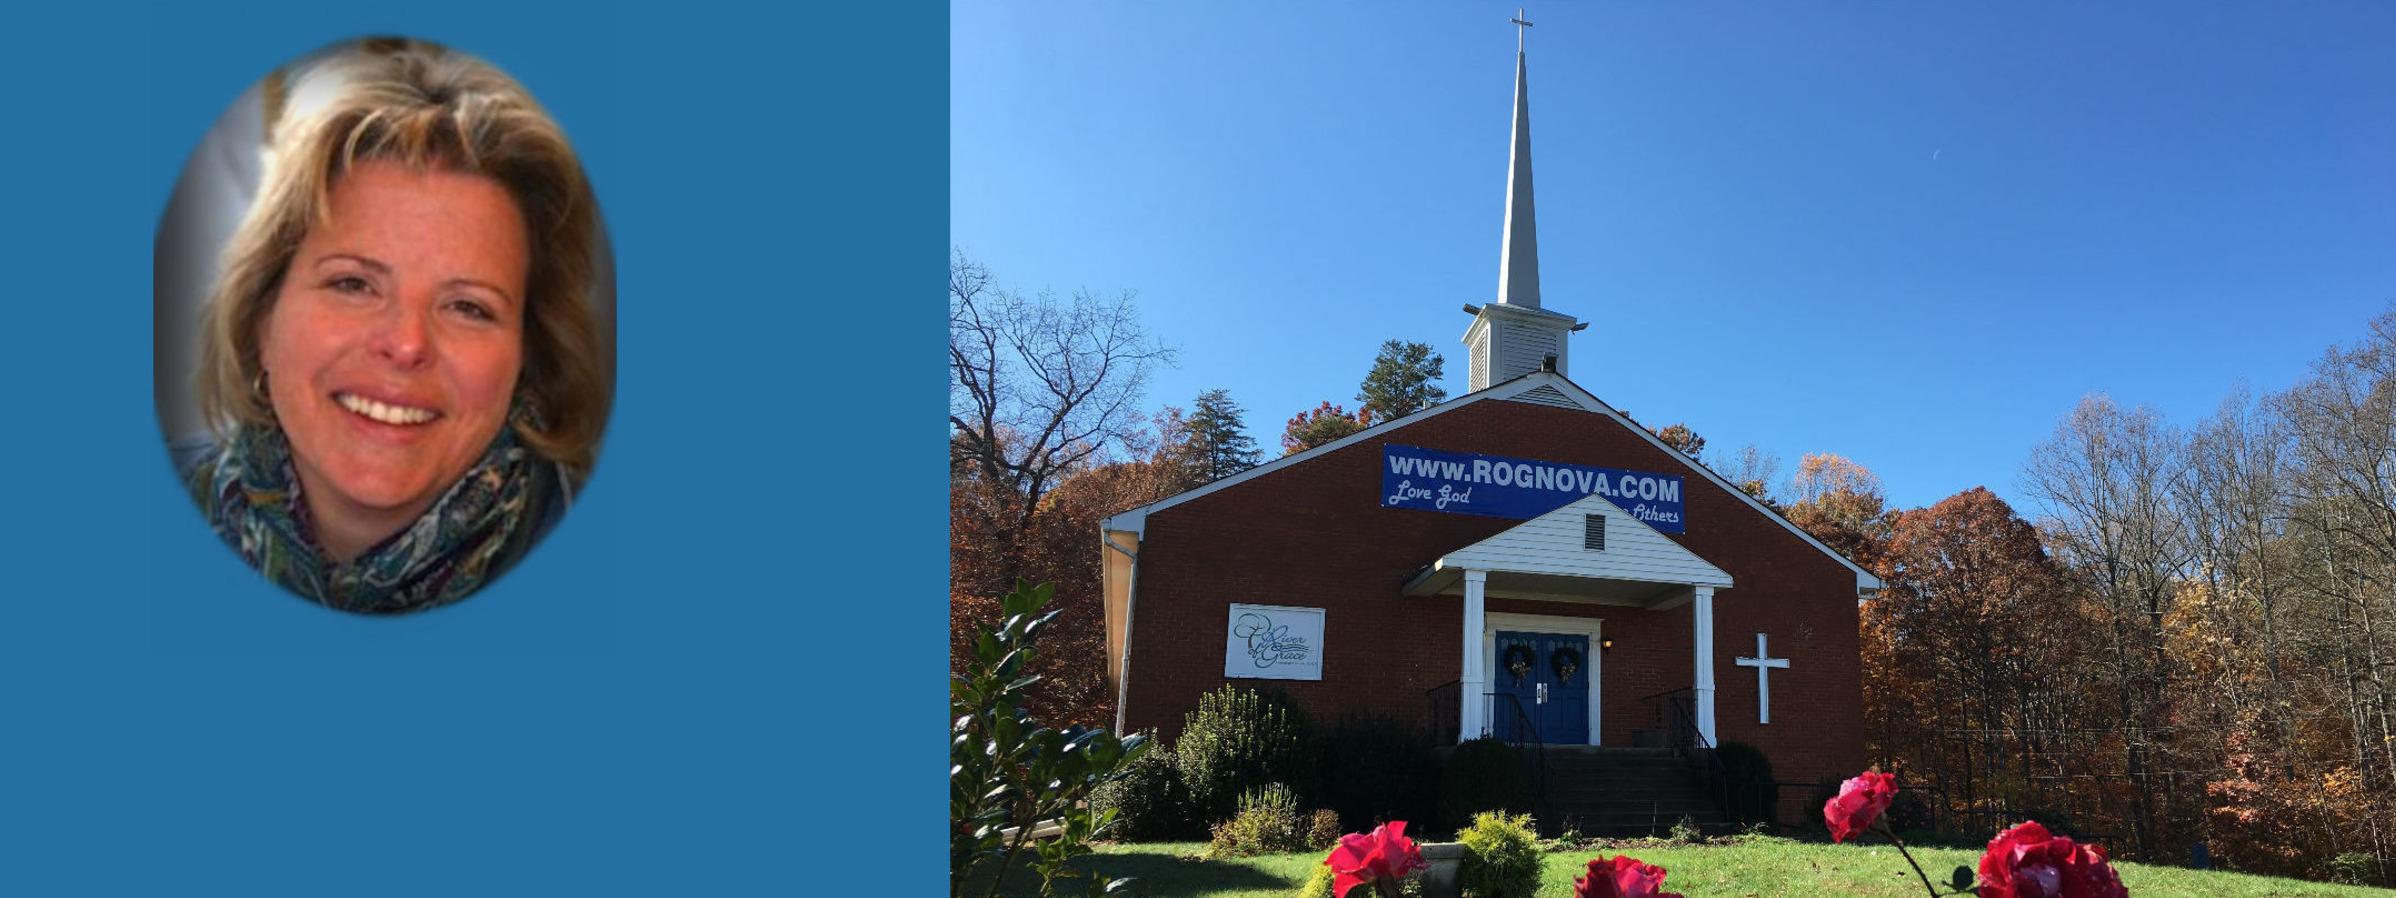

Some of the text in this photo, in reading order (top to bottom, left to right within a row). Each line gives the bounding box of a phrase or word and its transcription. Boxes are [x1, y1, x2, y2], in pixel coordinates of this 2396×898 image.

[1388, 480, 1472, 510] Love God
[1261, 625, 1306, 649] River
[1255, 641, 1306, 668] Grace
